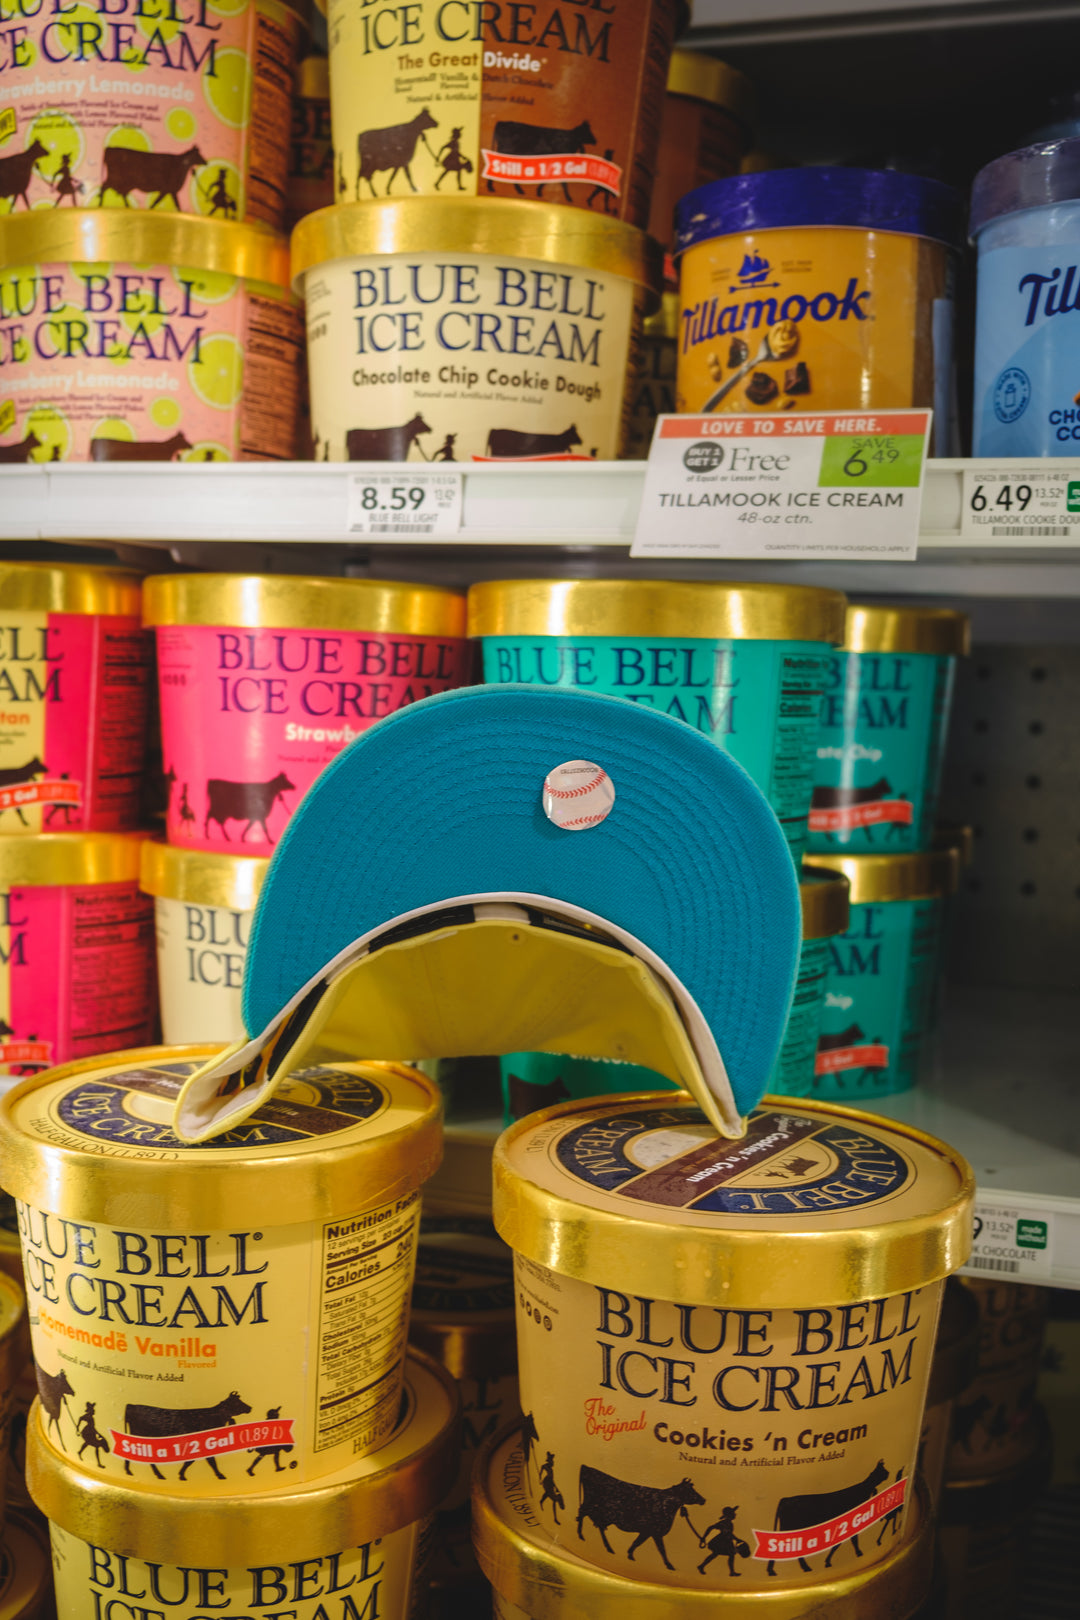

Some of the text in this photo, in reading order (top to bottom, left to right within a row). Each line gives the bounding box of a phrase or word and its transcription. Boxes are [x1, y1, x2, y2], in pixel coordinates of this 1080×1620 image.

[362, 0, 613, 63] ICE CREAM
[40, 22, 220, 78] CREAM
[398, 51, 541, 72] The Great Divide
[89, 76, 195, 102] Lemonade
[492, 157, 521, 174] Still
[525, 165, 536, 176] a
[564, 162, 587, 175] Gal
[82, 275, 208, 319] BELL
[352, 264, 480, 309] BLUE
[495, 265, 605, 321] BELL
[681, 278, 872, 354] Tillamook
[34, 320, 205, 364] CREAM
[354, 311, 602, 367] ICE CREAM
[77, 371, 180, 392] Lemonade
[352, 365, 602, 403] Chocolate Chip Cookie Dough
[702, 418, 882, 434] LOVE TO SAVE HERE.
[852, 437, 895, 450] SAVE
[686, 458, 709, 467] GET
[728, 447, 791, 472] Free
[686, 475, 694, 483] of
[696, 475, 718, 483] Equal
[758, 474, 780, 482] Price
[361, 487, 425, 510] 8.59
[659, 492, 903, 508] TILLAMOOK ICE CREAM
[971, 485, 1032, 512] 6.49
[369, 514, 438, 522] BLUE BELL LIGHT
[737, 512, 813, 525] 48-oz ctn.
[972, 515, 1057, 525] TILLAMOOK COOKIE
[216, 634, 343, 673] BLUE
[357, 639, 453, 679] BELL
[497, 647, 741, 688] BLUE BELL
[218, 677, 290, 714] ICE
[187, 948, 244, 989] ICE
[72, 1092, 116, 1117] ICE
[30, 1117, 51, 1136] HALF
[48, 1132, 110, 1154] GALLON
[574, 1119, 645, 1176] CREAM
[749, 1132, 789, 1158] Cookies
[686, 1163, 735, 1183] Cream
[728, 1136, 898, 1211] BLUE BELL
[327, 1209, 392, 1240] Nutrition
[327, 1239, 378, 1261] Serving Size
[982, 1245, 1037, 1261] CHOCOLATE
[325, 1261, 381, 1288] Calories
[66, 1272, 269, 1329] CREAM
[325, 1296, 356, 1311] Total Fat
[39, 1306, 217, 1358] Homemade Vanilla
[322, 1323, 363, 1342] Cholesterol
[594, 1285, 922, 1357] BLUE BELL
[322, 1339, 349, 1352] Sodium
[322, 1353, 341, 1363] Total
[57, 1350, 184, 1383] Natural and Artificial Flavor Added
[178, 1359, 217, 1369] Flavored
[596, 1336, 918, 1412] ICE CREAM
[320, 1389, 346, 1403] Protein
[584, 1398, 616, 1418] The
[586, 1410, 648, 1441] Original
[653, 1421, 868, 1451] Cookies Cream
[122, 1439, 153, 1458] Still
[156, 1447, 168, 1458] a
[173, 1440, 200, 1457] 1/2
[205, 1432, 235, 1451] Gal
[239, 1426, 268, 1444] (1.89
[678, 1448, 846, 1467] Natural and Artificial Flavor Added
[768, 1504, 875, 1553] Still a 1/2 Gal
[87, 1543, 231, 1608] BLUE
[247, 1538, 384, 1607] BELL
